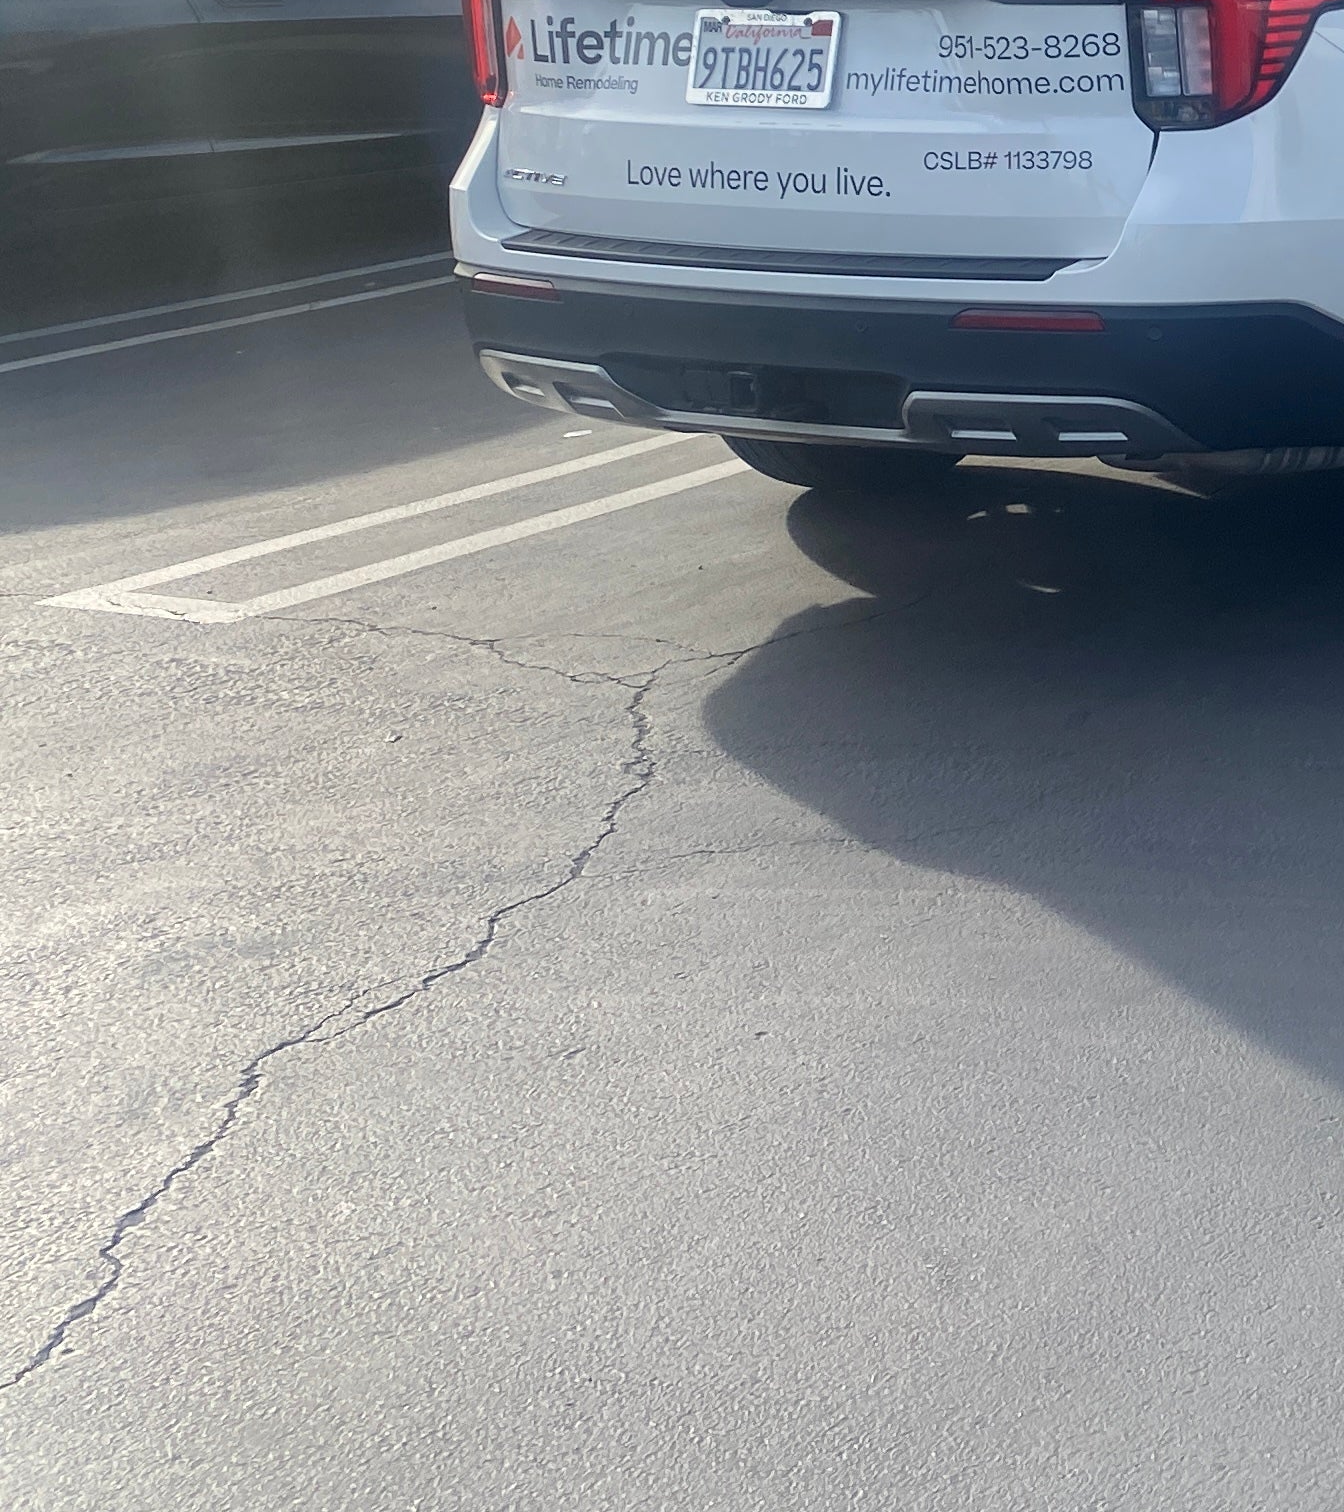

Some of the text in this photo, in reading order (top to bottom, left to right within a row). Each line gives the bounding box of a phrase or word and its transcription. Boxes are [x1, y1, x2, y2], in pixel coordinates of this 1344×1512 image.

[747, 13, 788, 22] SAN DIEGO
[530, 15, 694, 67] Lifetime
[938, 32, 1121, 60] 951-523-8268
[699, 47, 824, 92] 9TBH625
[846, 67, 1125, 97] mylifetimehome.com
[535, 74, 639, 95] Home Remodeling
[706, 92, 808, 105] KEN GRODY FORD
[923, 150, 1093, 171] CSLB# 1133798
[627, 159, 891, 200] Love where you live.
